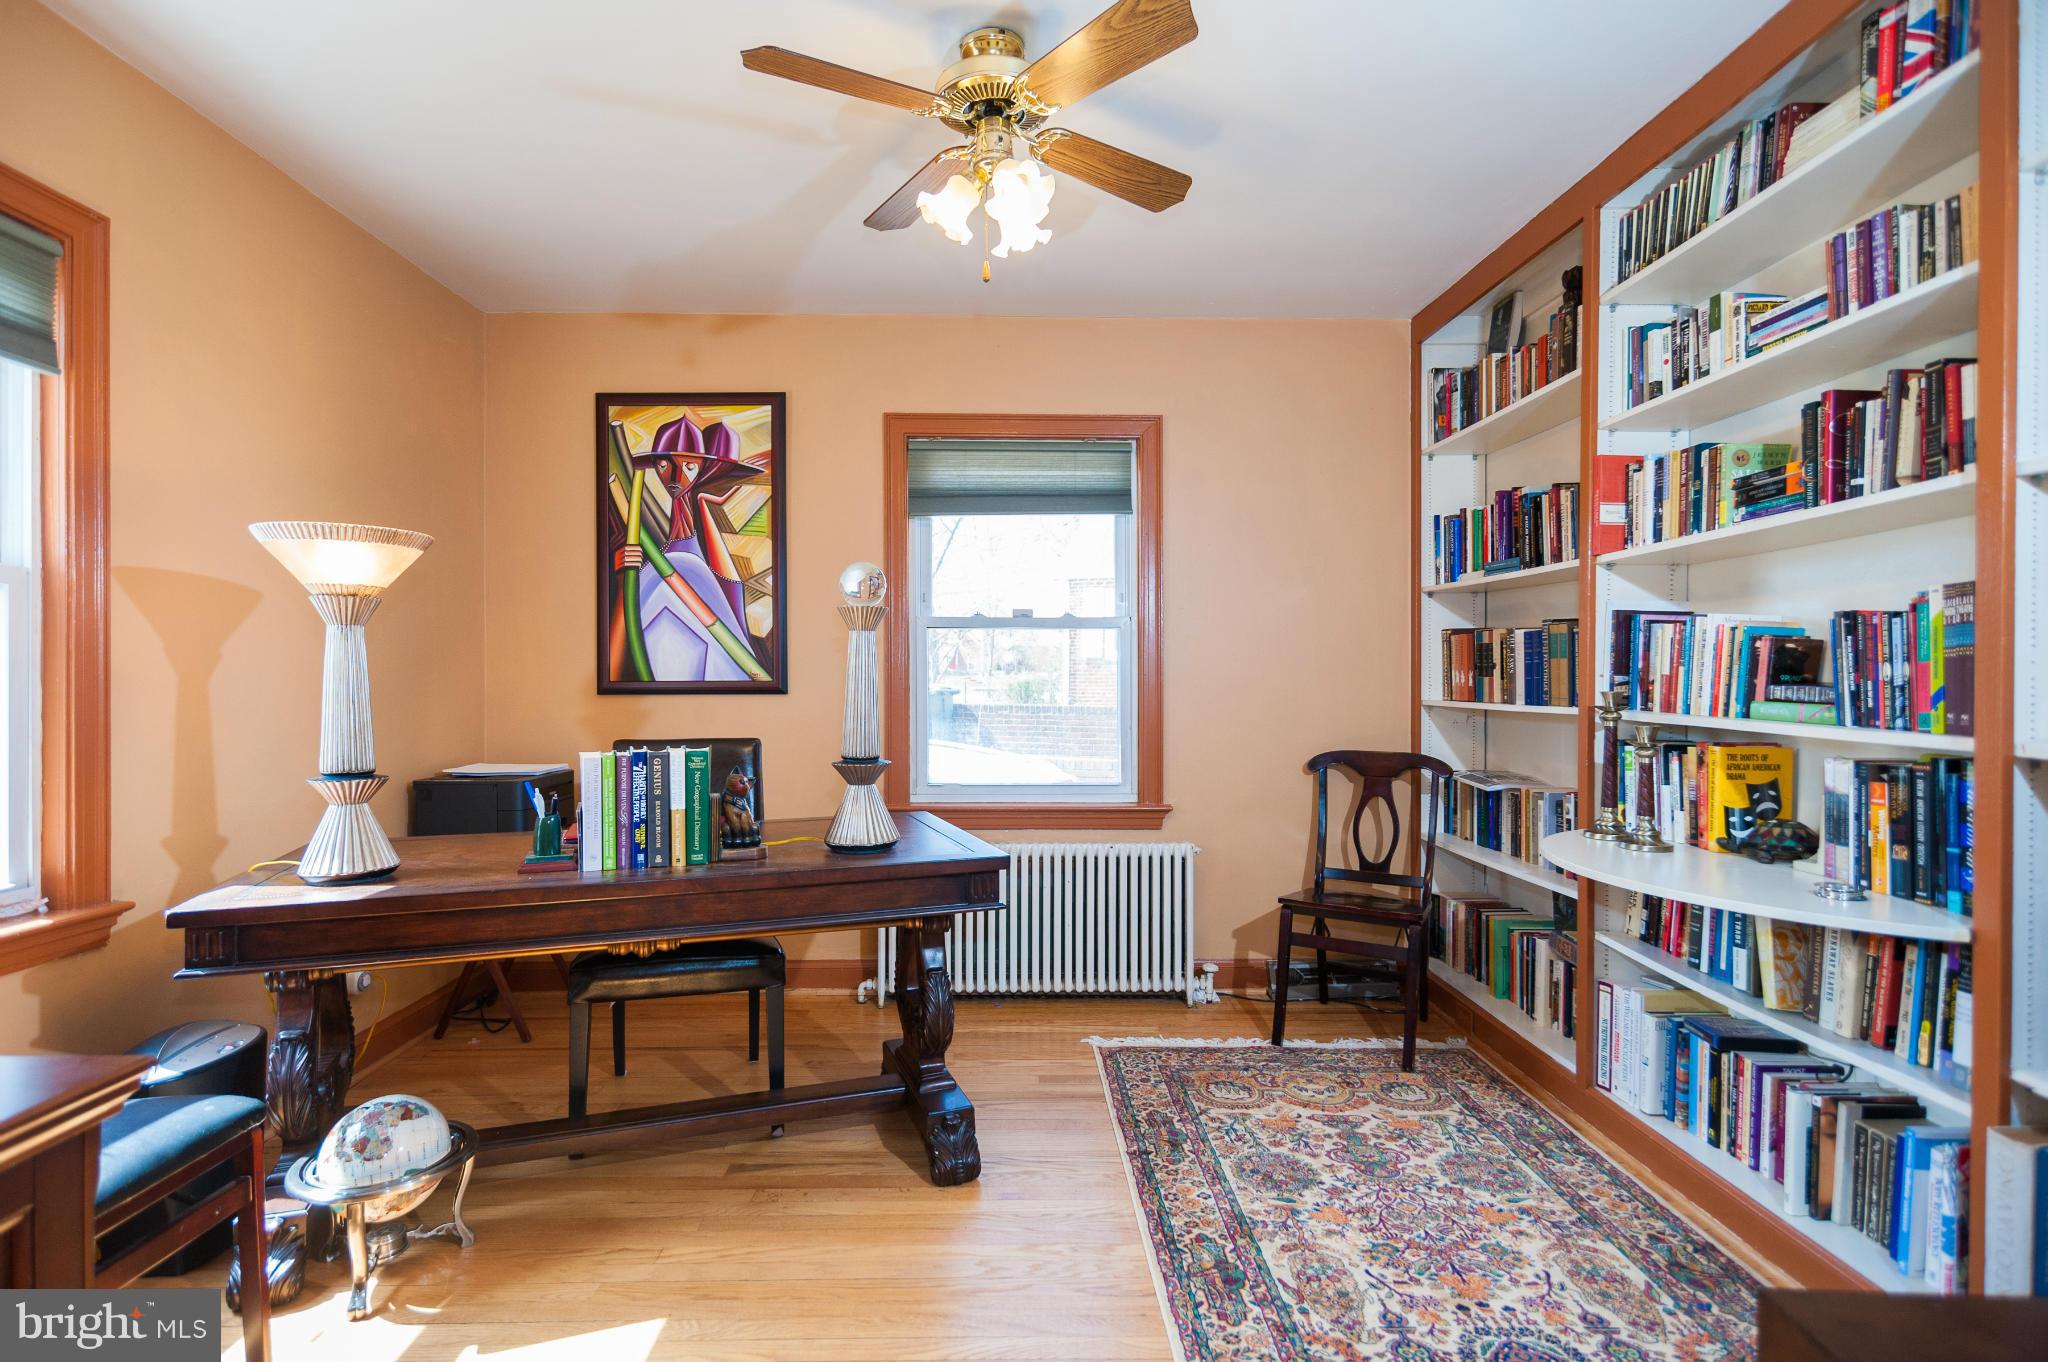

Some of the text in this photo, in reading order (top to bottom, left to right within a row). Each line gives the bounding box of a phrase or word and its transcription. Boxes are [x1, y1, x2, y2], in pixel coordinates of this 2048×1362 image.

[653, 758, 661, 795] GENIUS
[693, 785, 701, 820] Geographical
[693, 822, 701, 850] Dictionary
[1825, 929, 1839, 1002] RUNAWAY SLAVES
[1622, 1006, 1631, 1037] WELLNESS
[1600, 1017, 1609, 1080] NUTRITIONAL HEALING
